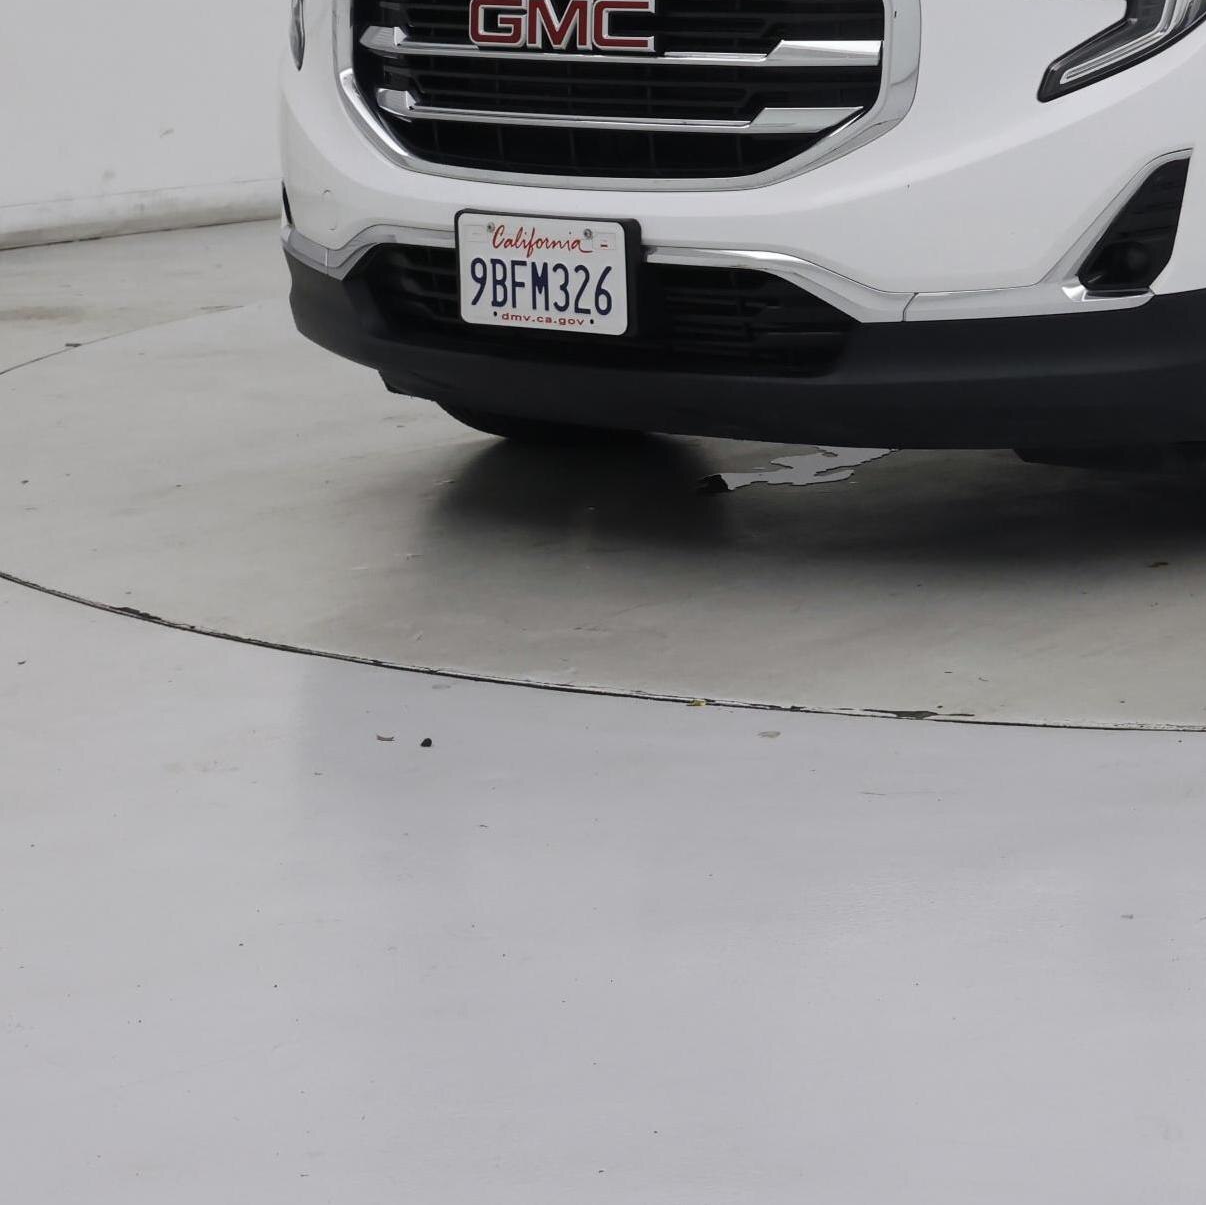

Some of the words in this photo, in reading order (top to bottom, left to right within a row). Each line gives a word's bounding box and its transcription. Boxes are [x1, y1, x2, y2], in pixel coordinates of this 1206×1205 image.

[491, 224, 594, 258] California
[470, 257, 613, 316] 9BFM326
[501, 312, 585, 326] dmv.ca.gov
